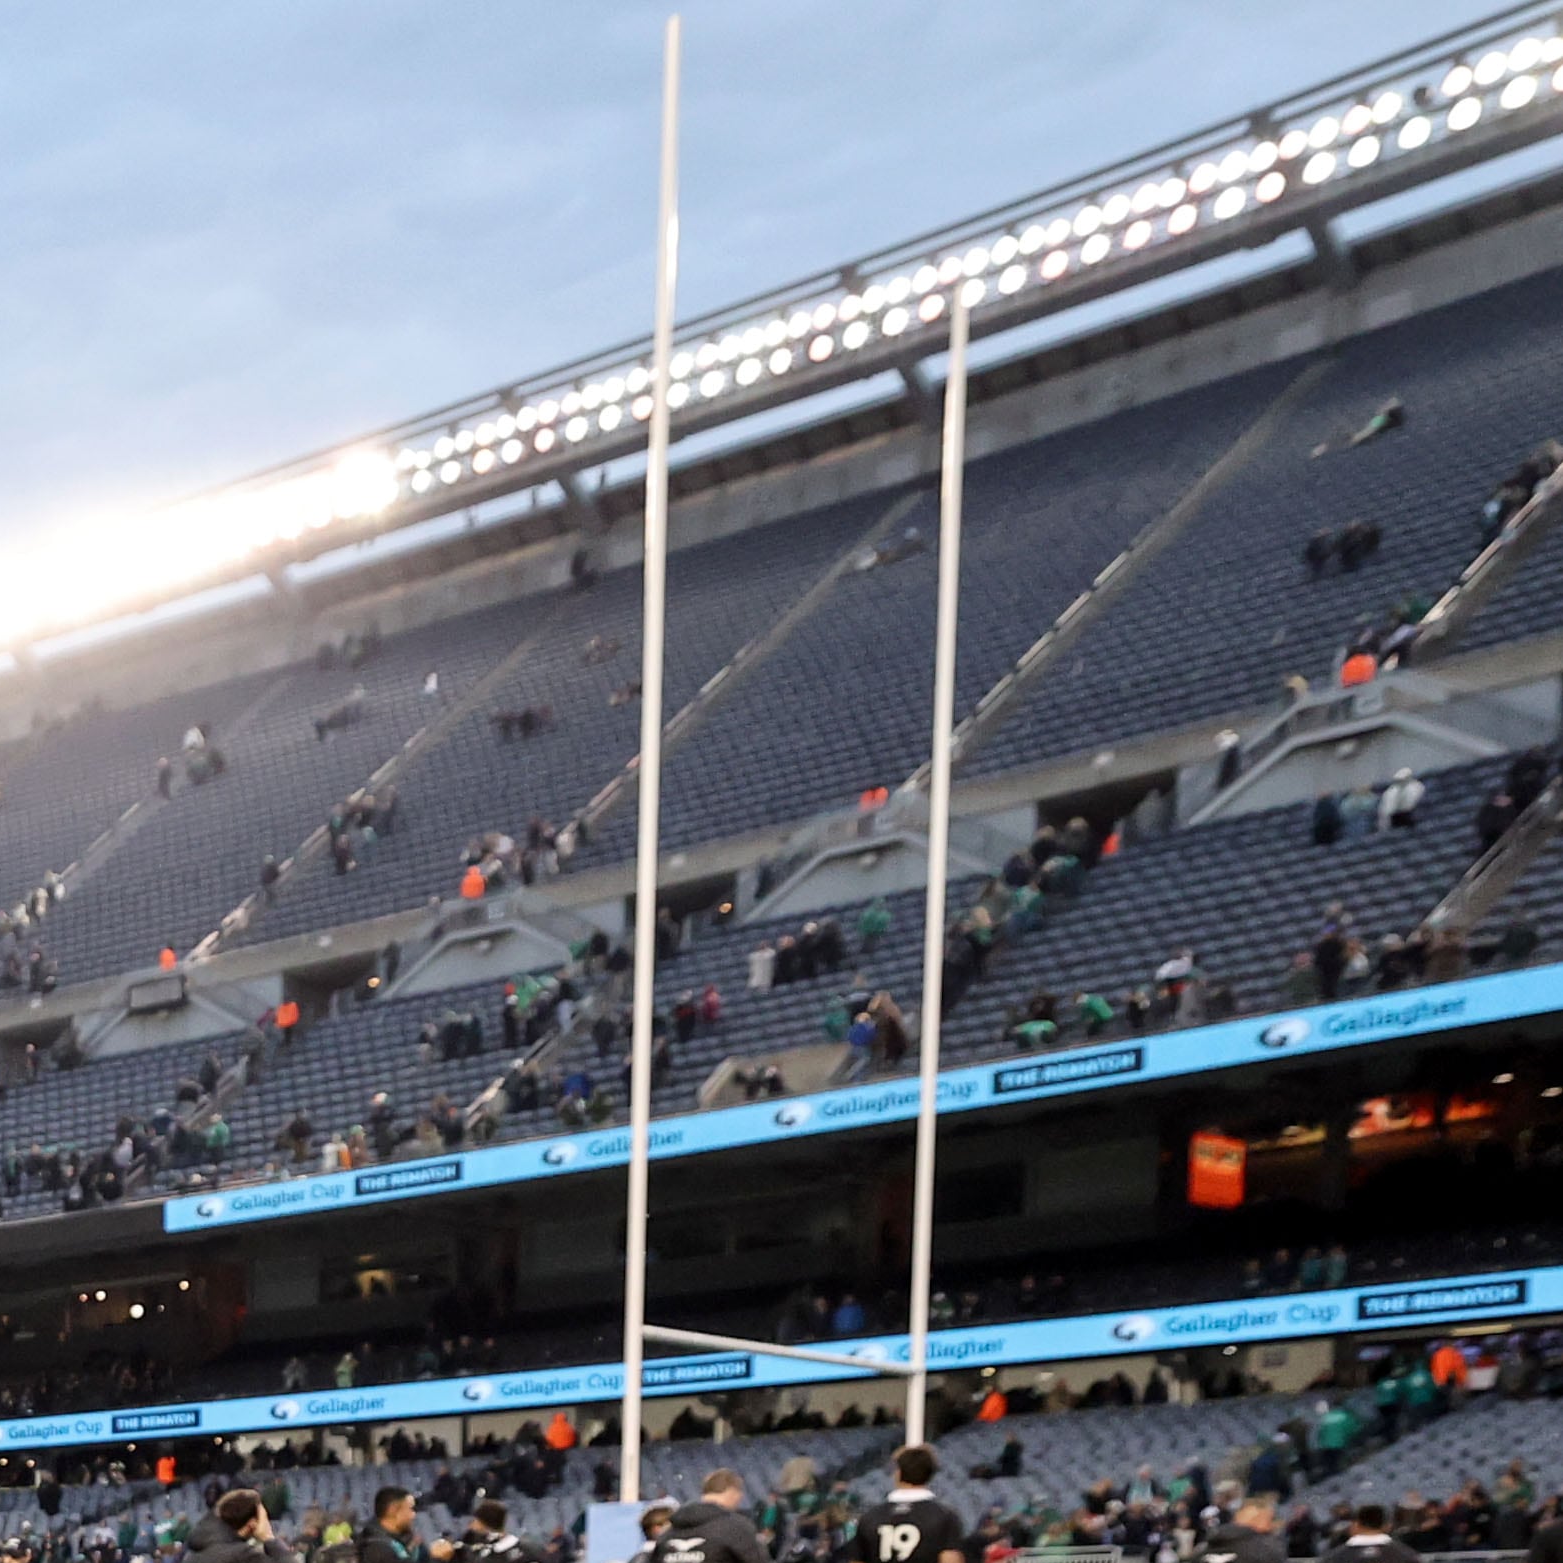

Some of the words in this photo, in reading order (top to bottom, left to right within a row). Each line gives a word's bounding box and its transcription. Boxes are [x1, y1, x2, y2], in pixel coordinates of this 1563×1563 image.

[231, 1188, 306, 1212] Gallagher
[311, 1182, 346, 1200] Cup
[1286, 1301, 1341, 1325] Cup
[500, 1375, 581, 1397] Gallagher
[307, 1396, 386, 1416] Gallagher
[7, 1423, 71, 1441] Gallagher
[75, 1419, 103, 1435] Cup
[116, 1417, 139, 1431] THE
[140, 1412, 196, 1427] REMATCH
[876, 1523, 922, 1563] 19
